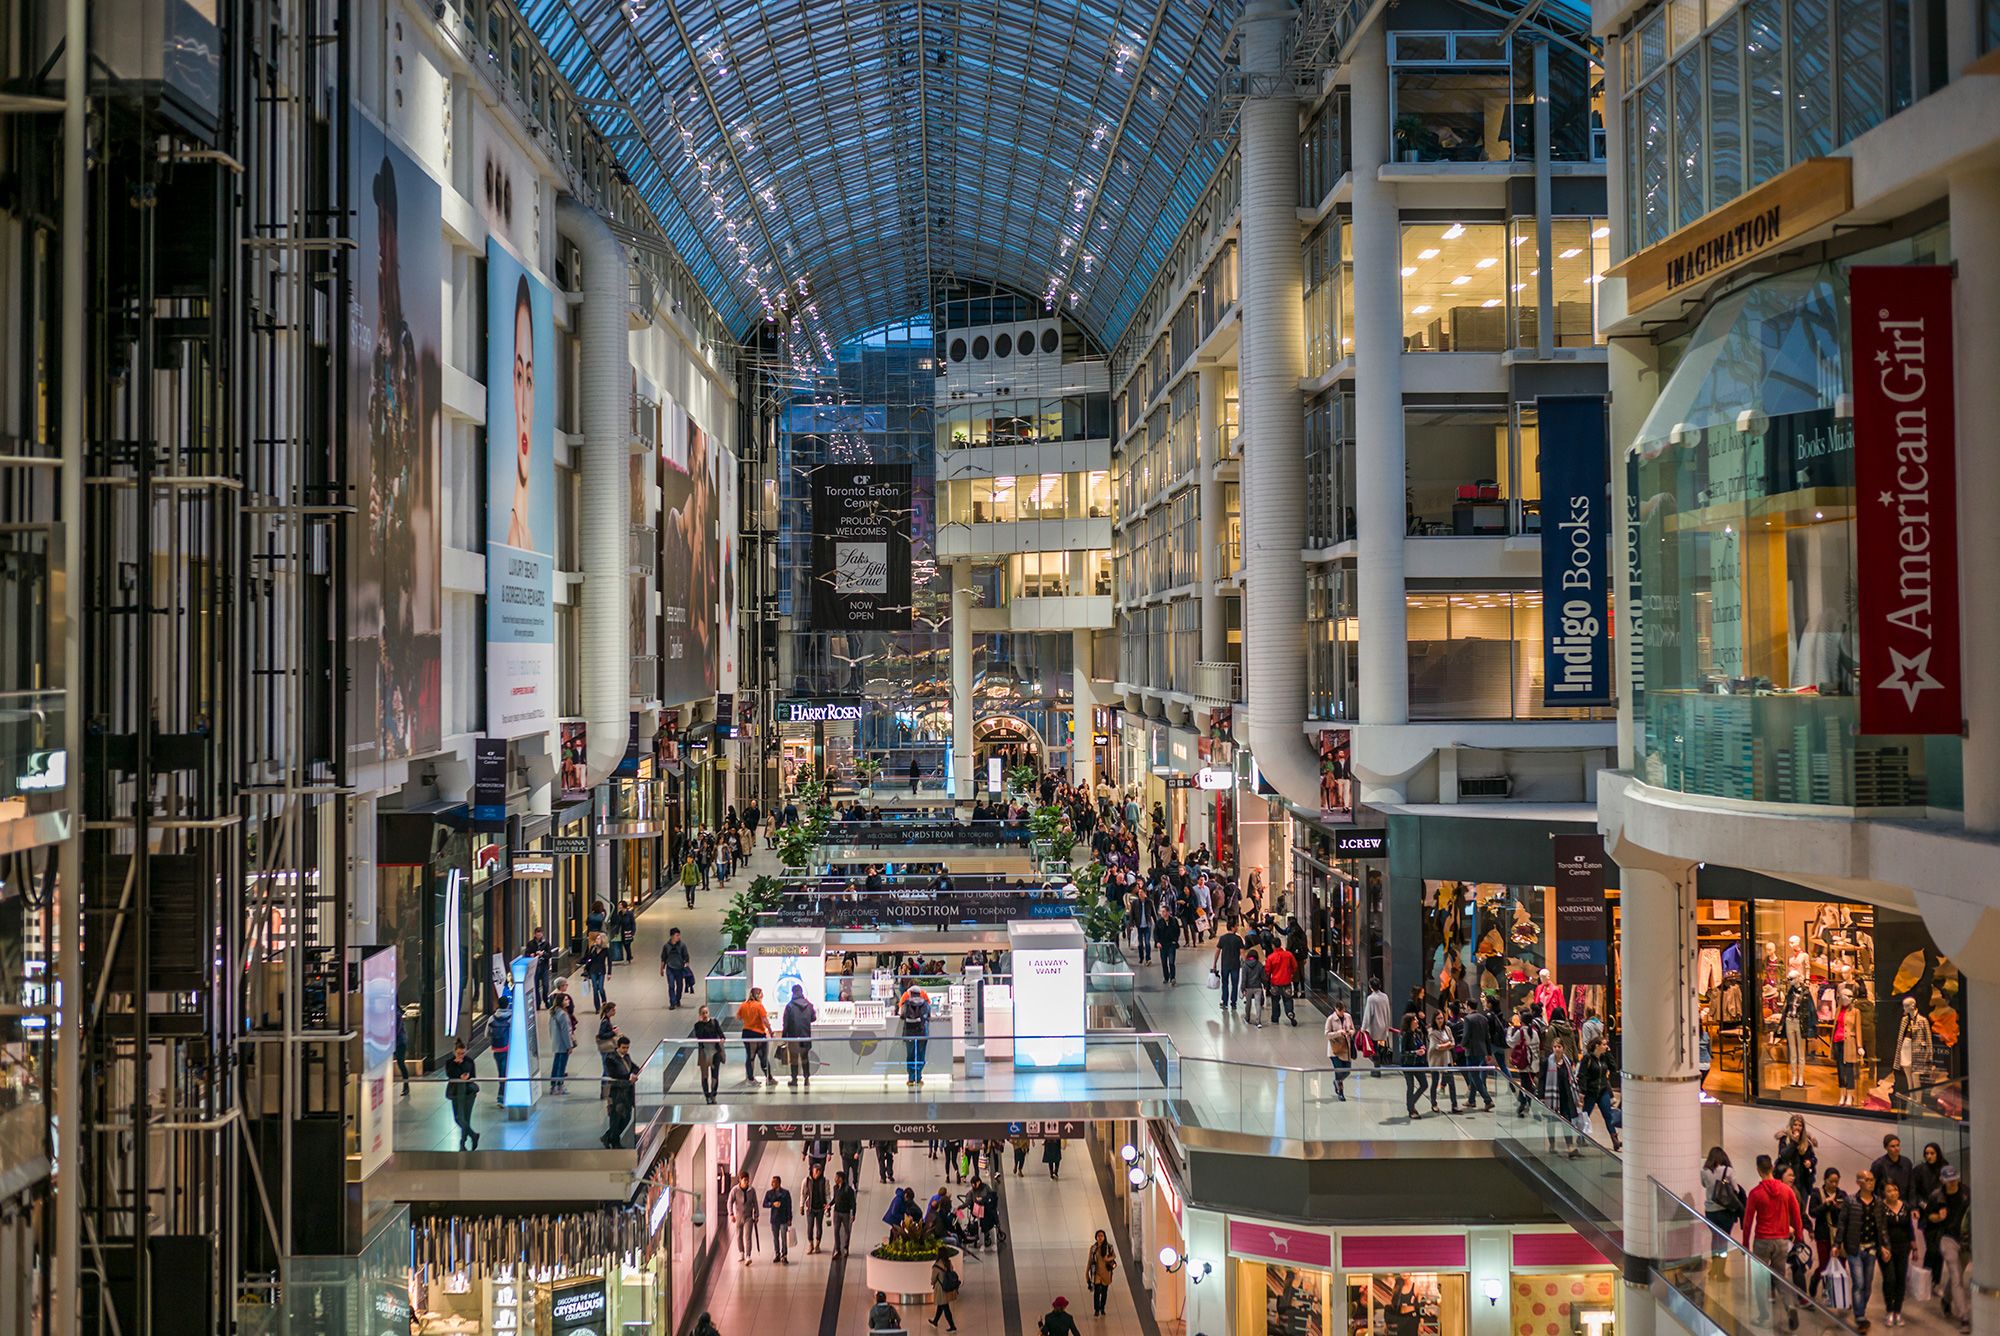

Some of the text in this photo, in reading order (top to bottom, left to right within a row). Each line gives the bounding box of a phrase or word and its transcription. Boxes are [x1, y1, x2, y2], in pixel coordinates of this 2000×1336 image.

[1667, 205, 1780, 290] IMAGINATION
[1797, 423, 1856, 460] Books Mui
[825, 486, 899, 496] Toronto Eaton
[844, 497, 879, 508] Centr
[840, 517, 882, 525] PROUDLY
[1880, 408, 1932, 640] American
[836, 527, 888, 536] WELCOMES
[1553, 495, 1599, 692] Indigo Books
[850, 601, 873, 610] NOW
[848, 611, 875, 620] OPEN
[790, 704, 862, 720] HARRY ROSEN
[902, 831, 954, 839] NORDSTROM
[1339, 838, 1382, 849] J.CREW
[837, 908, 880, 917] WELCOMES
[886, 905, 960, 917] NORDSTROM
[966, 907, 978, 915] TO
[979, 907, 1017, 915] TORONTO
[1034, 907, 1052, 915] NOW
[1571, 945, 1590, 953] NOW
[1570, 952, 1591, 960] OPEN
[1034, 959, 1069, 967] ALWAYS
[1035, 967, 1061, 975] WANT
[893, 1124, 939, 1134] Queen St.
[553, 1296, 604, 1317] CRYSTALDUST
